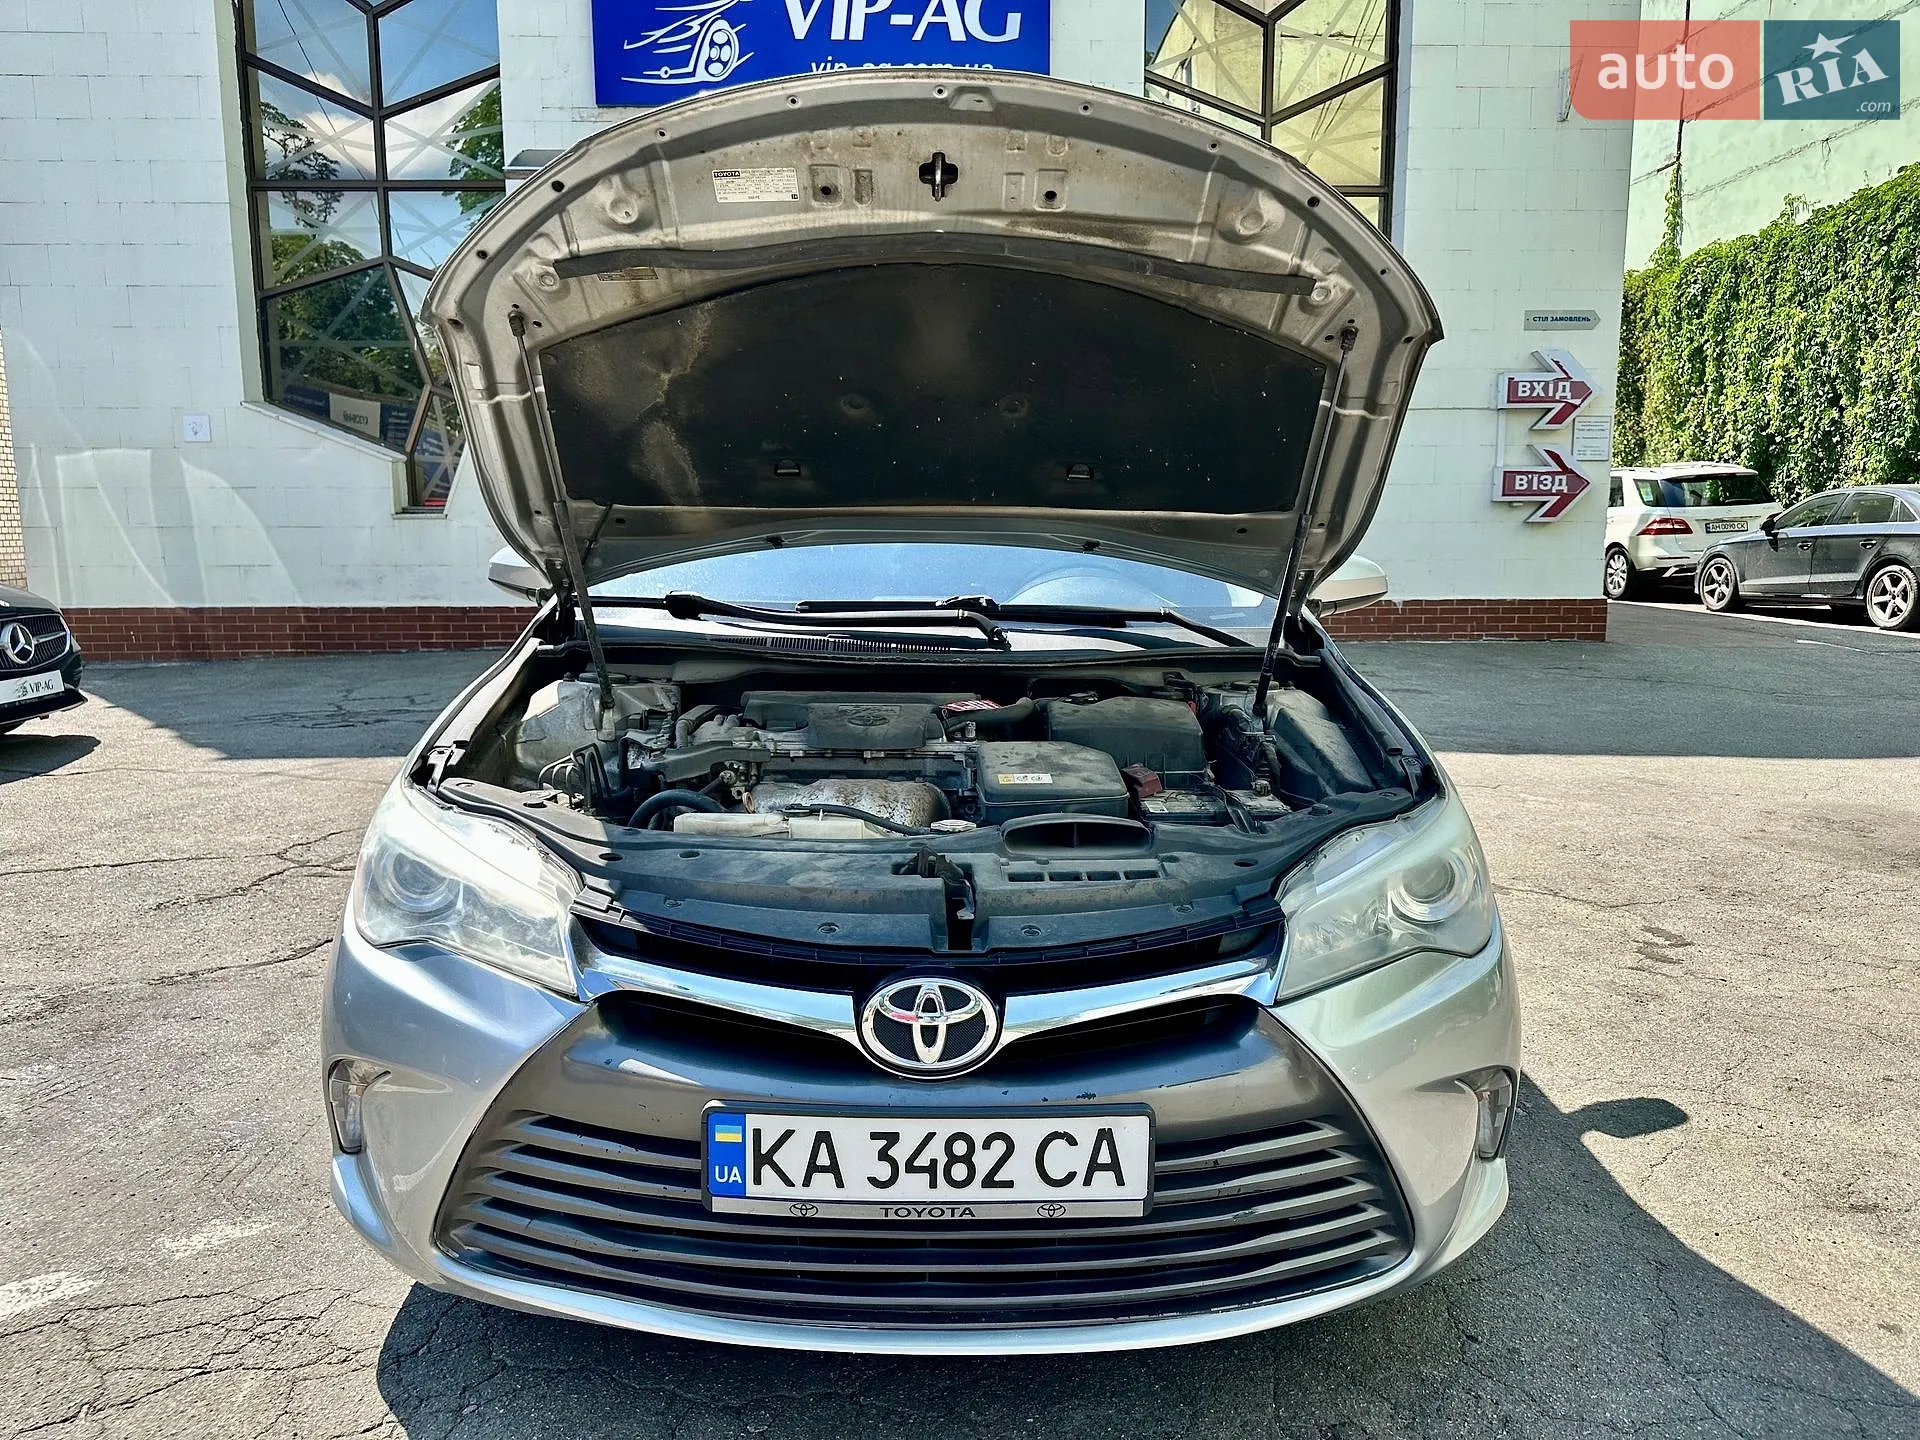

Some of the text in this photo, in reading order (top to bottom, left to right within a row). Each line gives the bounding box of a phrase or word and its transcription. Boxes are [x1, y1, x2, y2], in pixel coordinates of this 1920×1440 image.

[784, 0, 1022, 43] VIP-AG
[1518, 381, 1572, 400] ВХІД
[29, 679, 54, 693] VIP-AG
[752, 1127, 1126, 1189] KA 3482 CA
[714, 1165, 742, 1184] UA
[879, 1206, 977, 1218] TOYOTA
